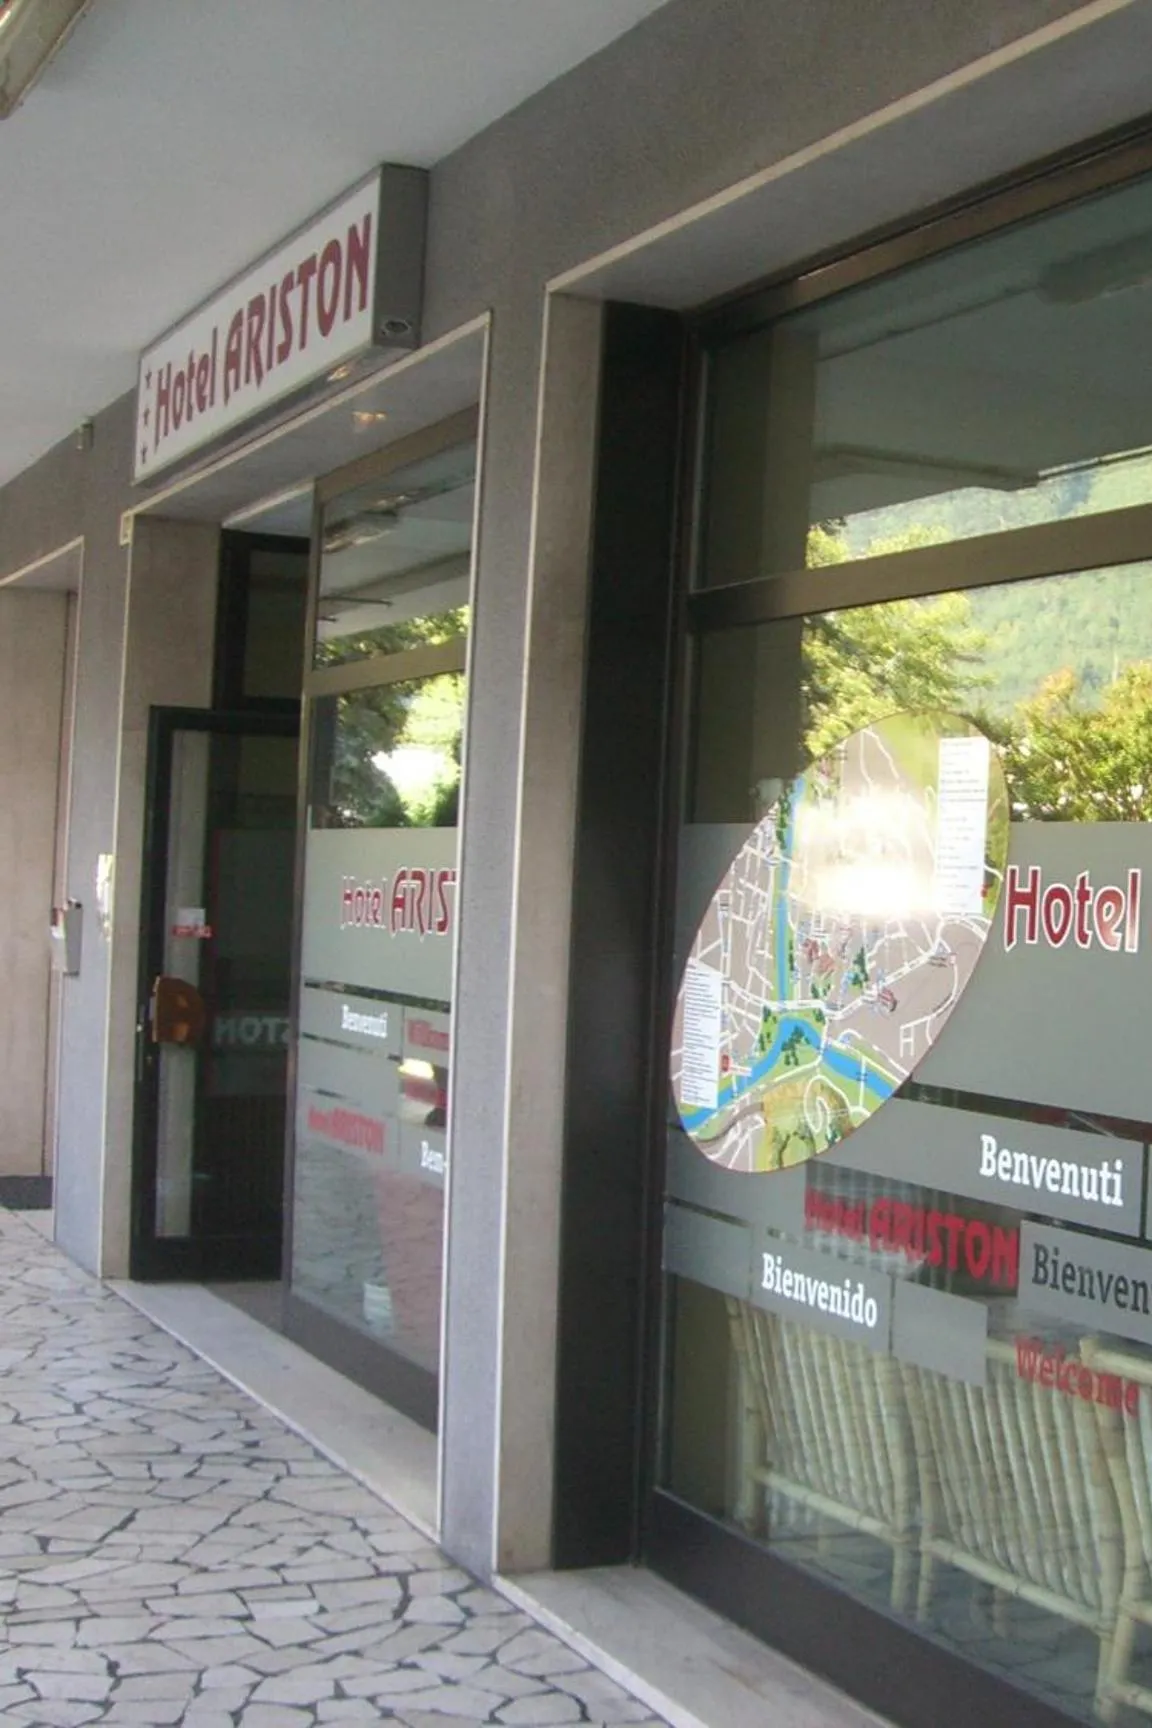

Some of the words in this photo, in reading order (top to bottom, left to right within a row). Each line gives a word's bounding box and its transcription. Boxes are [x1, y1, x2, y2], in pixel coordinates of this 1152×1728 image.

[154, 326, 218, 454] Hotel
[223, 211, 372, 406] ARISTON
[1003, 864, 1141, 953] Hotel
[980, 1134, 1124, 1208] Benvenuti
[869, 1196, 1020, 1289] ARISTON
[761, 1252, 879, 1329] Bienvenido
[1014, 1335, 1139, 1418] Welcome
